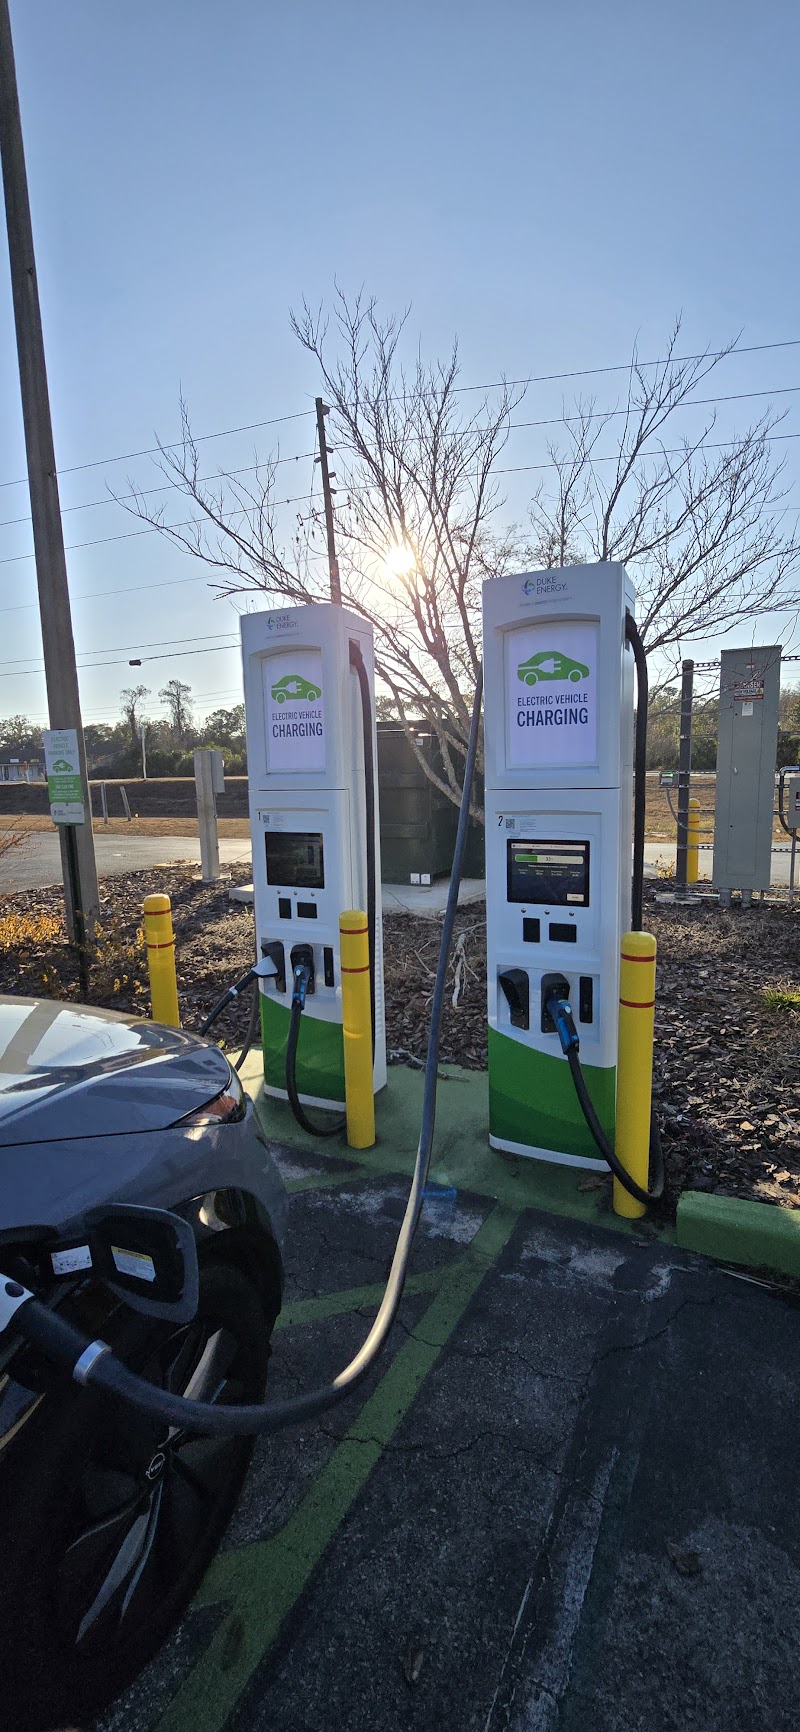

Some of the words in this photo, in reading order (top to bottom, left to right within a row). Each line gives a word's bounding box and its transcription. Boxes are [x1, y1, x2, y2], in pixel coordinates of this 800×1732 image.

[536, 576, 557, 586] DUKE
[536, 583, 567, 594] ENERGY
[517, 695, 553, 706] ELECTRIC
[555, 693, 588, 704] VEHICLE
[272, 712, 298, 720] ELECTRIC
[299, 711, 322, 719] VEHICLE
[517, 707, 588, 727] CHARGING
[272, 722, 323, 738] CHARGING
[257, 811, 261, 821] 1
[498, 815, 503, 826] 2
